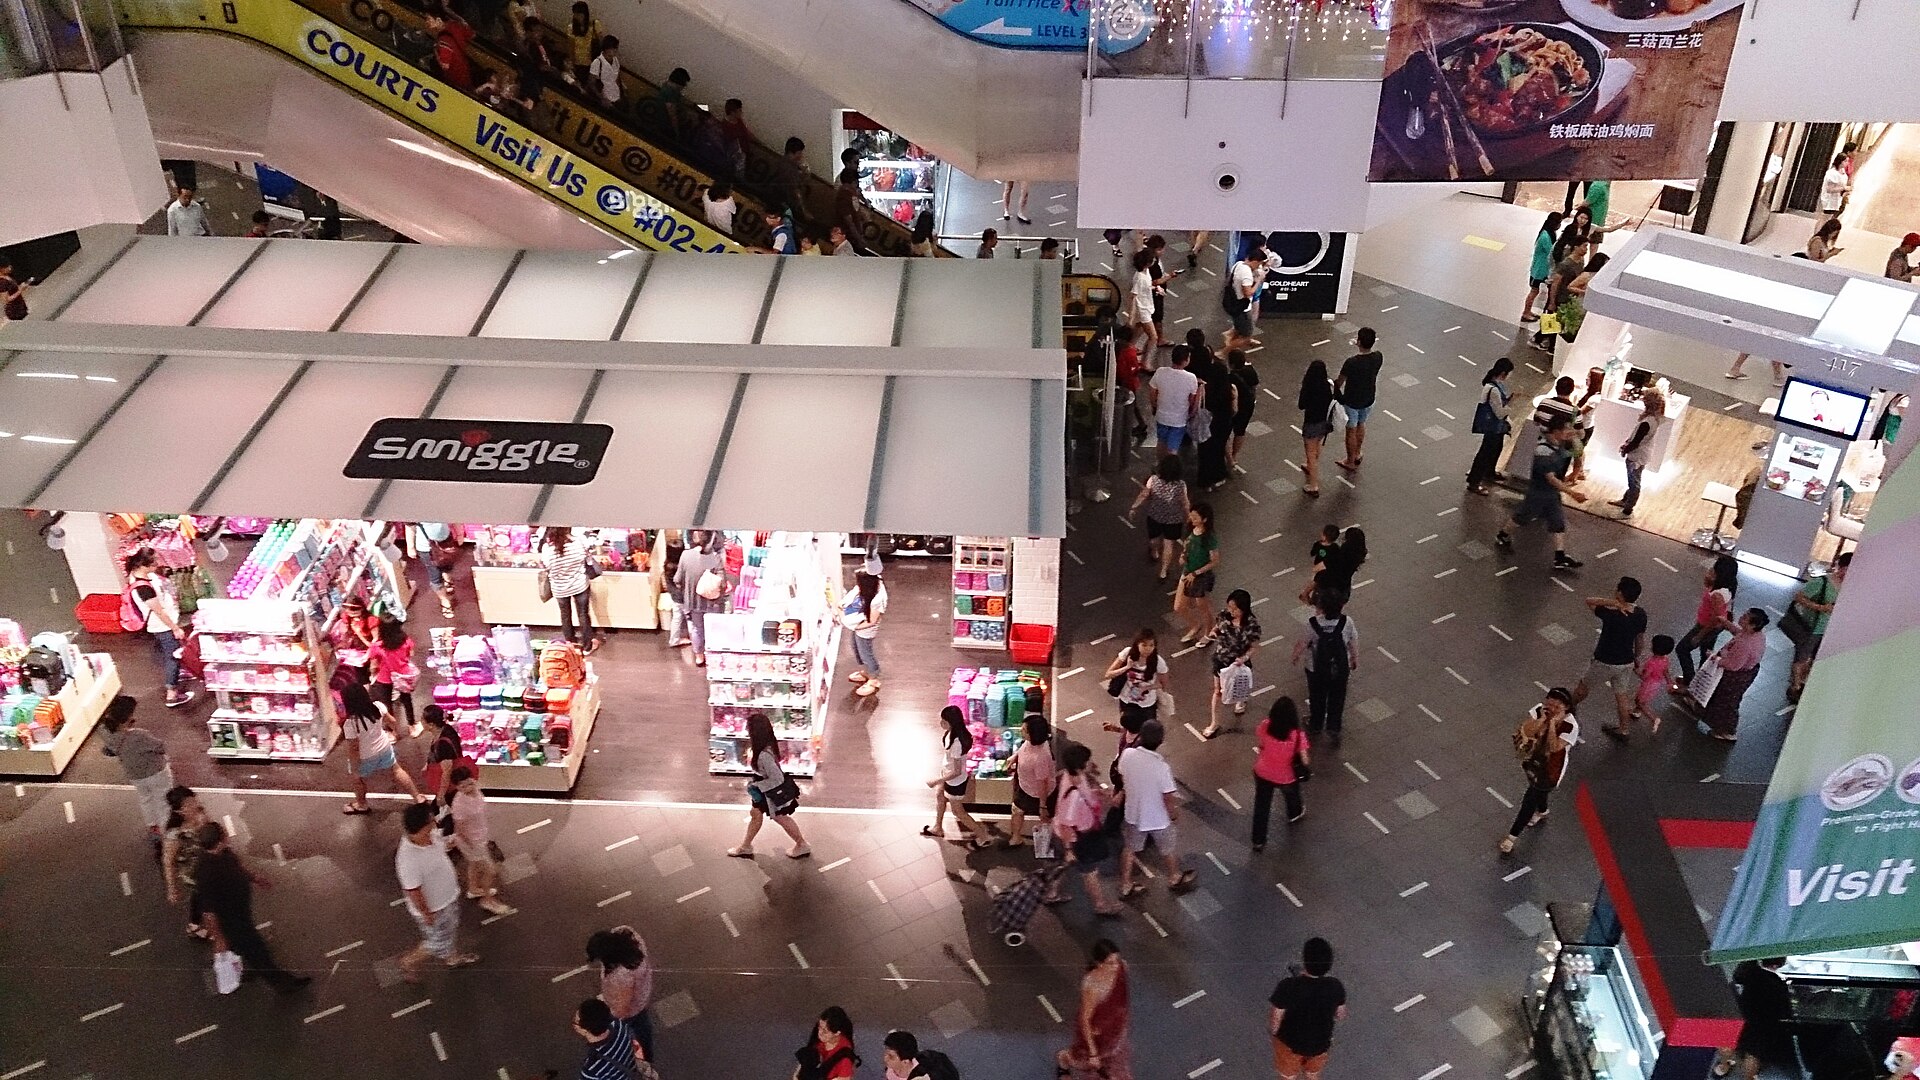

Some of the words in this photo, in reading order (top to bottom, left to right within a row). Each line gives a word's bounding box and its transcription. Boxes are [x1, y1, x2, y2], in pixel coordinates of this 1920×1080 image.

[1037, 25, 1076, 37] LEVEL
[1079, 28, 1088, 39] 3
[1625, 33, 1704, 49] 三菇西兰花
[307, 29, 439, 113] COURTS
[1549, 123, 1655, 139] 铁板麻油鸡焖面
[574, 117, 613, 158] Us
[620, 146, 652, 176] @
[475, 113, 542, 173] Visit
[546, 155, 588, 197] Us
[596, 184, 628, 216] @
[368, 437, 579, 471] smiggle
[1820, 808, 1920, 827] Premium-Grade
[1854, 826, 1868, 834] to
[1871, 821, 1906, 833] Fight
[1787, 858, 1917, 907] Visit
